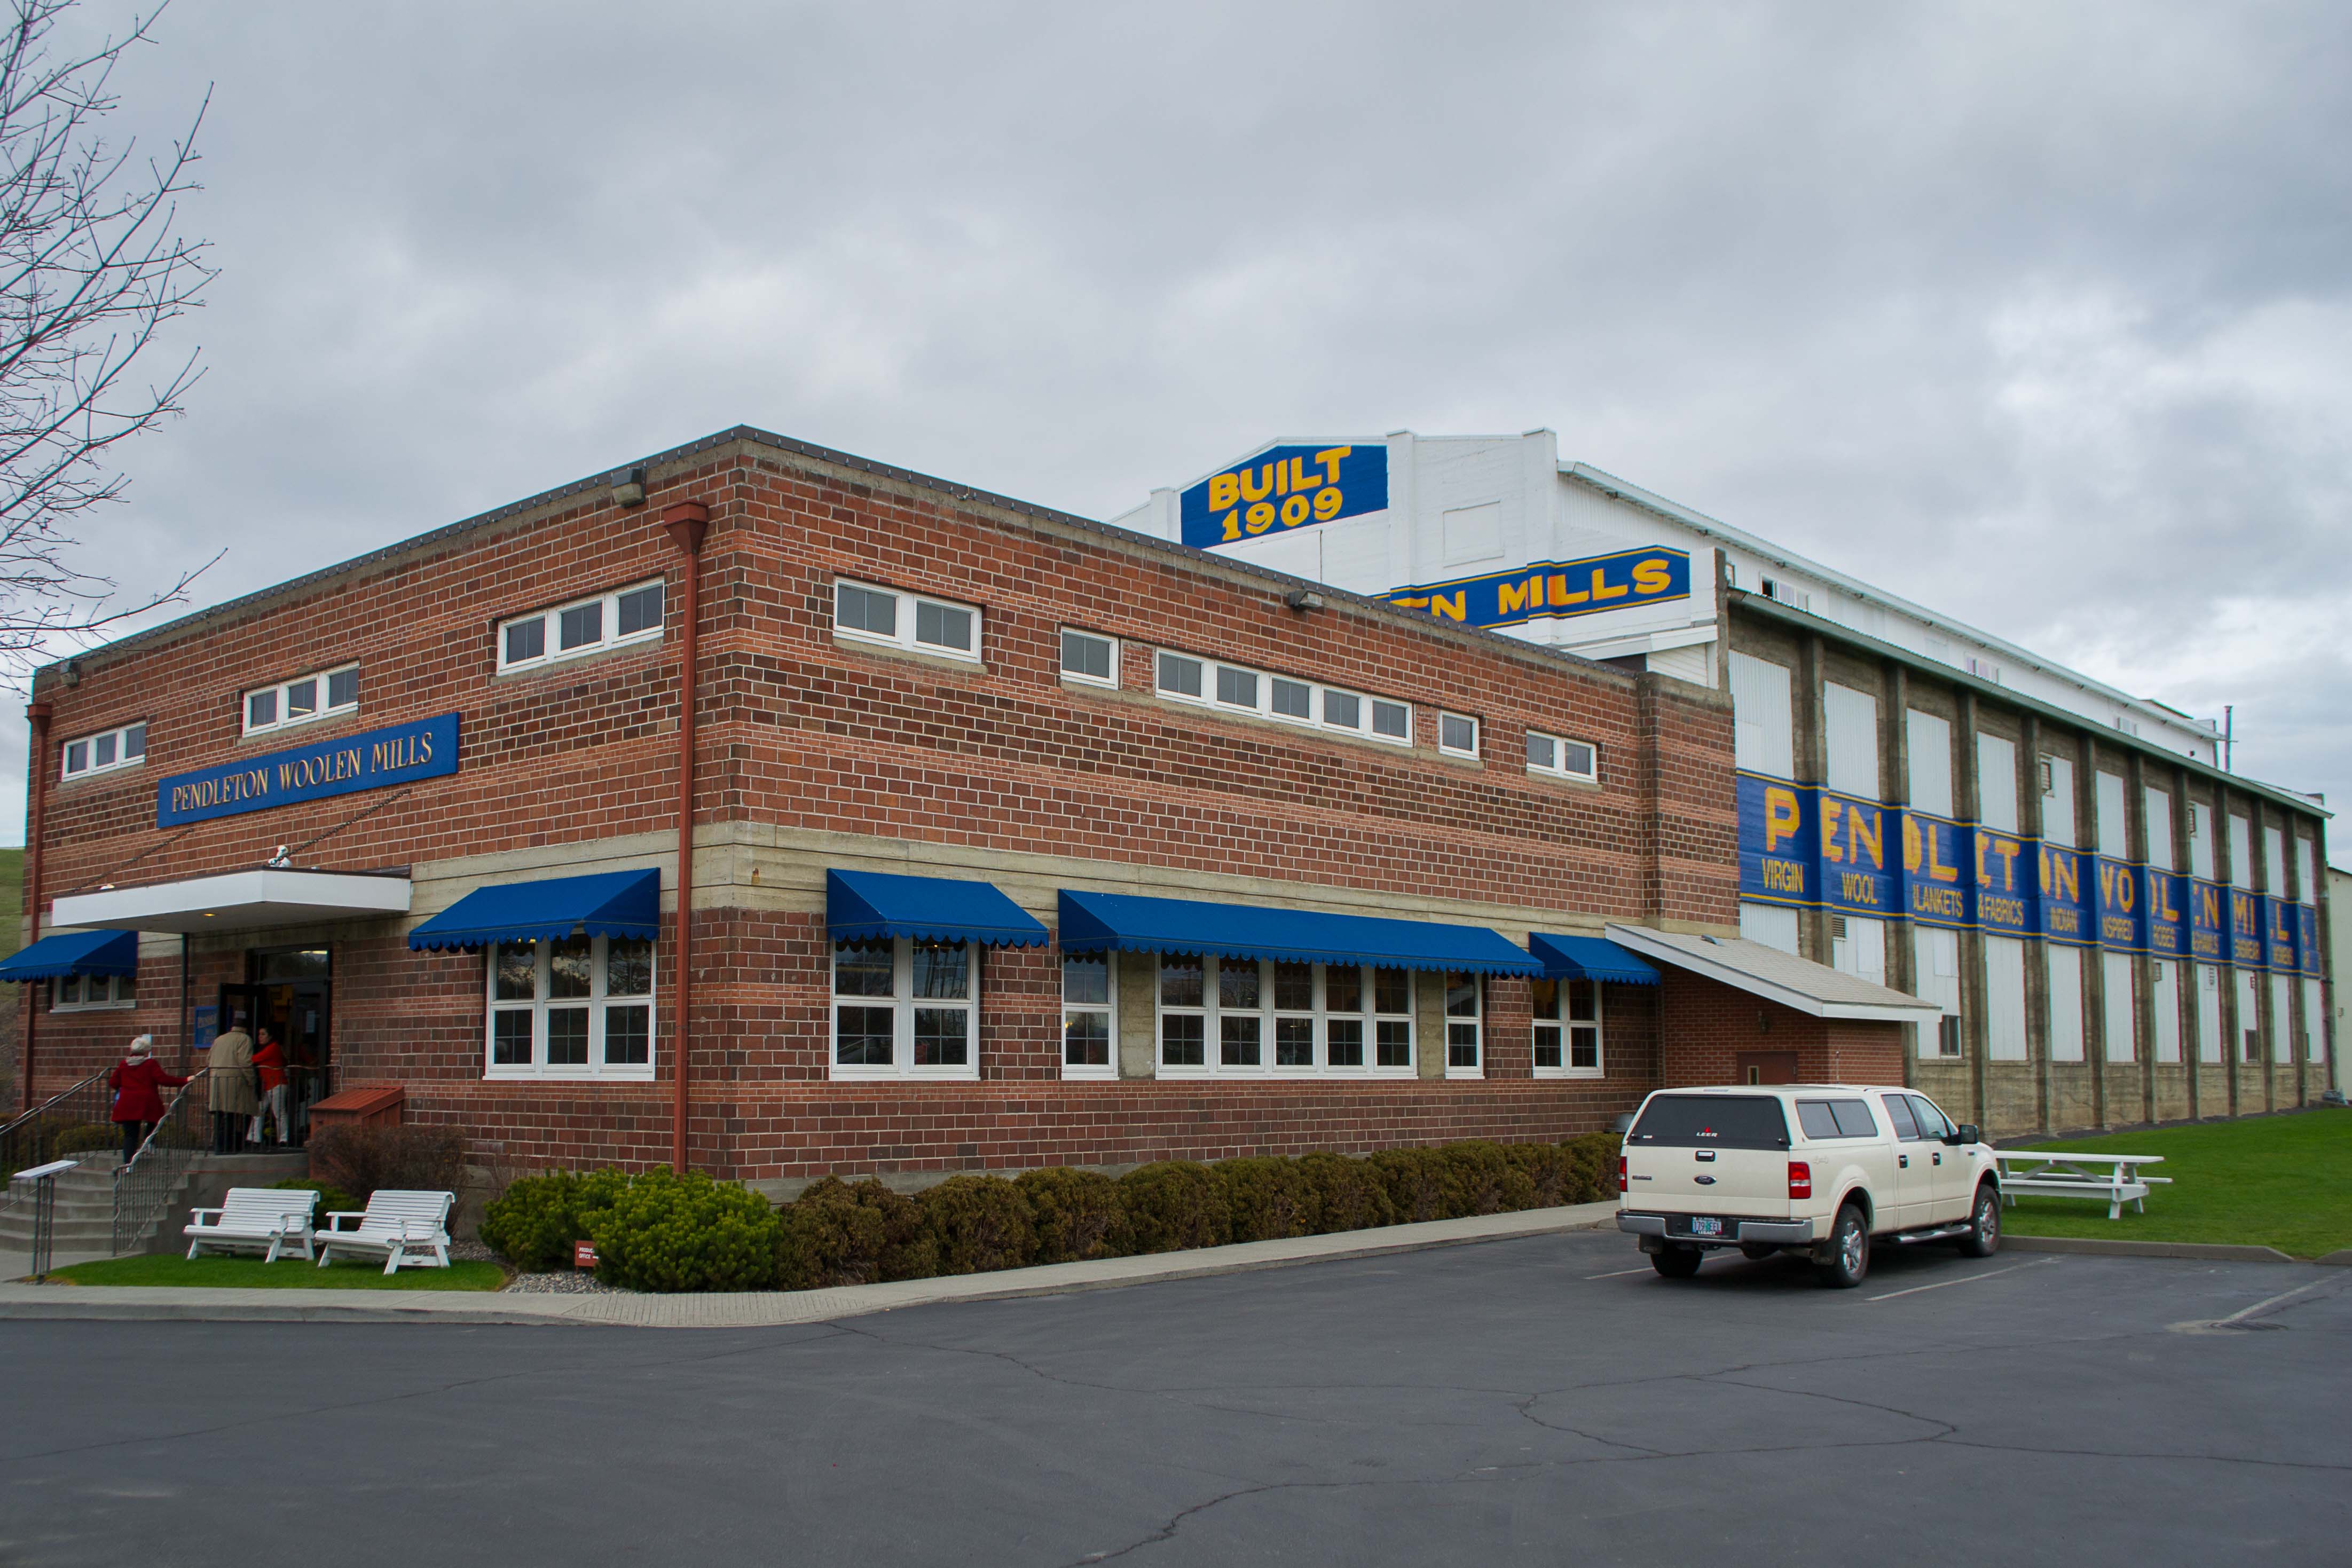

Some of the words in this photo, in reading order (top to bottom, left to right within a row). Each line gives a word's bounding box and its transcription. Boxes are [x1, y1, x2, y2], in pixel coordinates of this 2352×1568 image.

[1208, 445, 1351, 512] BUILT
[1222, 486, 1343, 541] 1909
[1498, 559, 1671, 614] MILLS
[172, 768, 269, 812] PENDLETON
[279, 747, 362, 791] WOOLEN
[371, 732, 432, 773] MILLS
[1762, 858, 1804, 893] VIRGIN
[1842, 872, 1878, 905] WOOL
[1913, 885, 1963, 918] LANKETS
